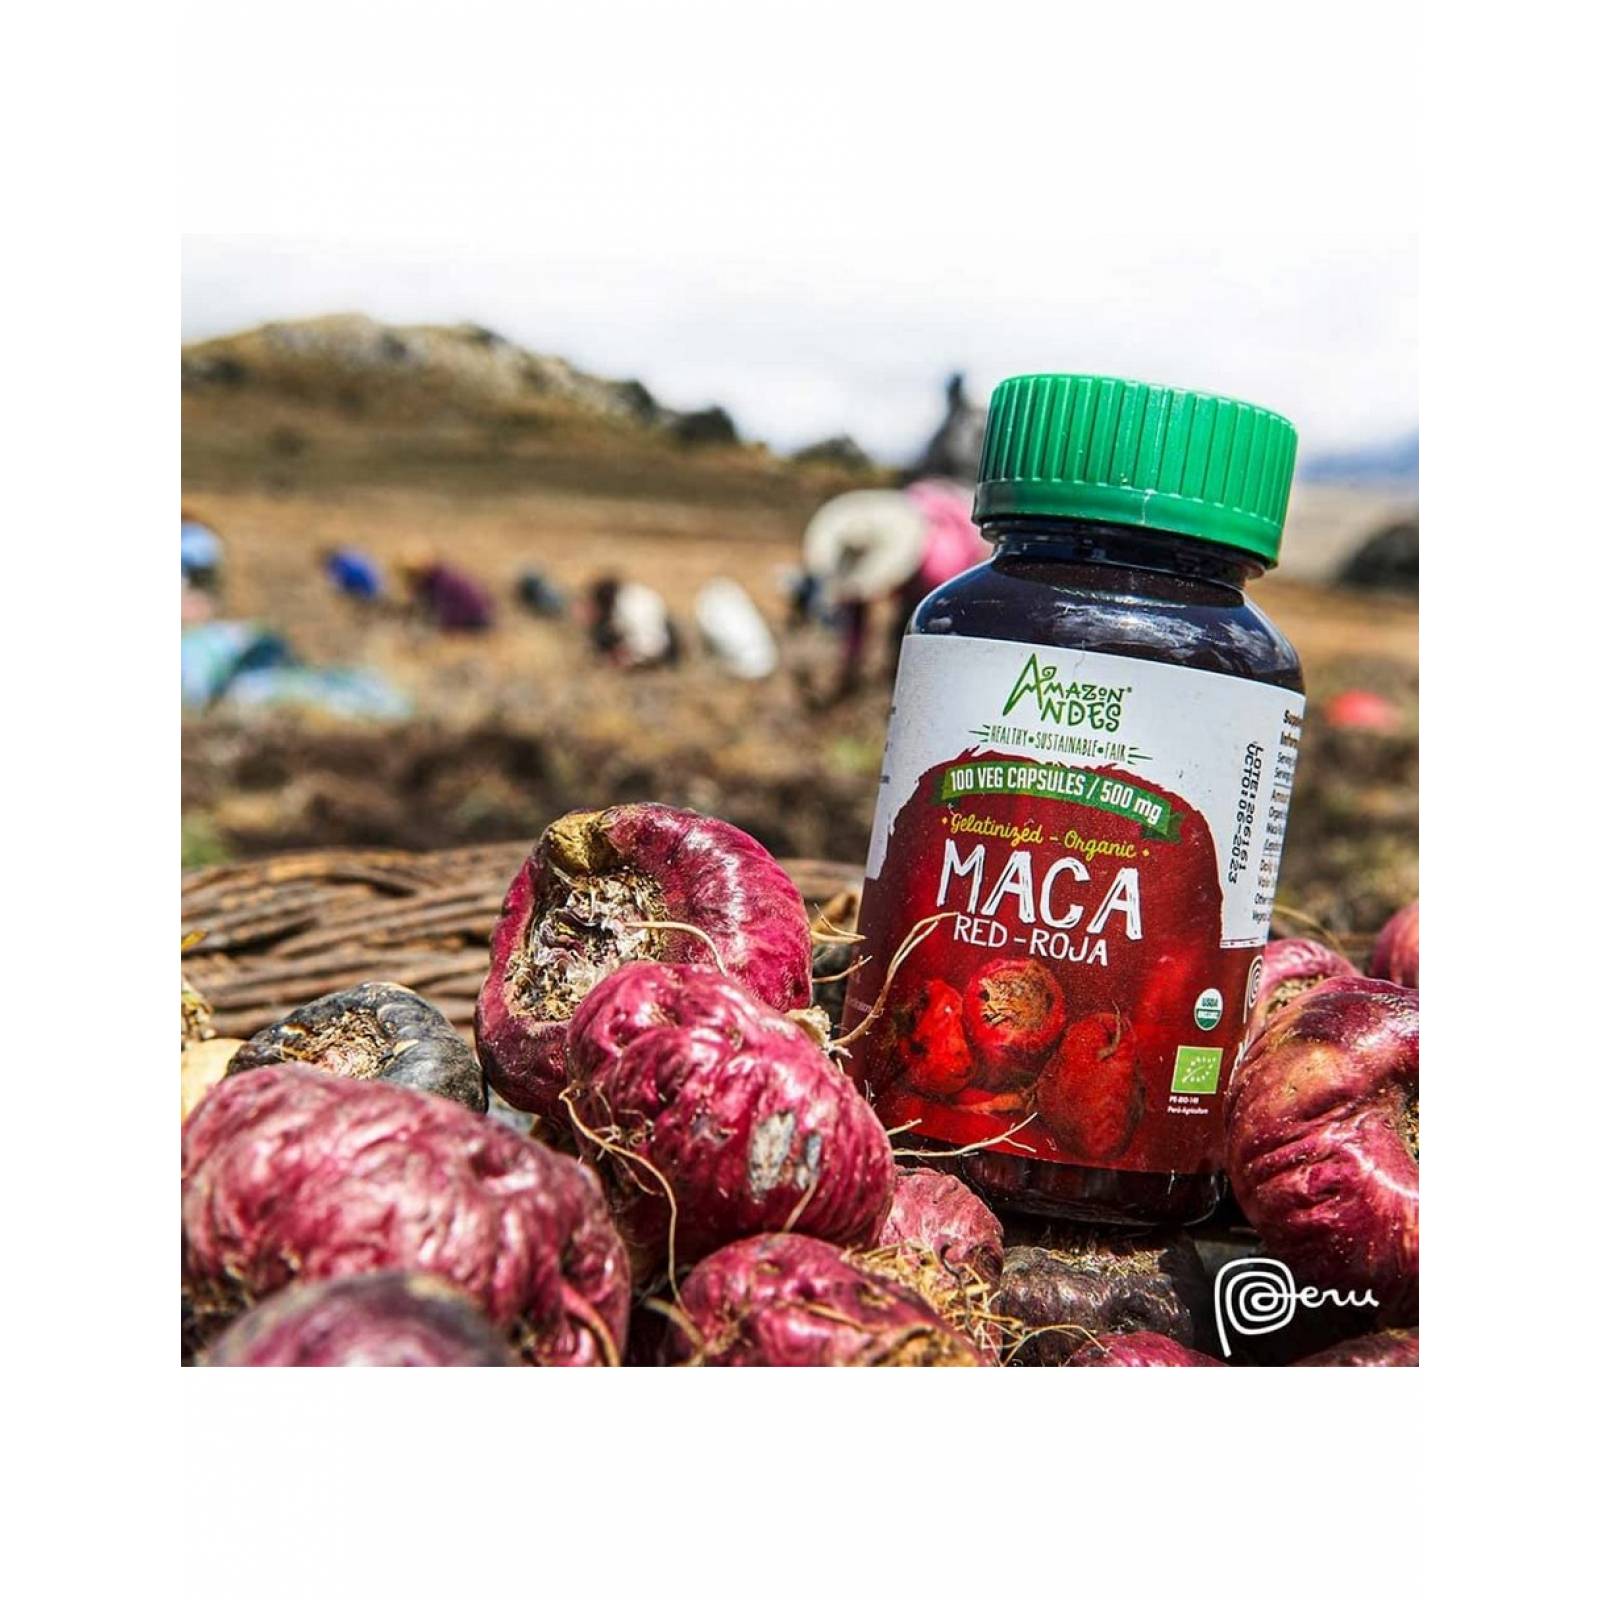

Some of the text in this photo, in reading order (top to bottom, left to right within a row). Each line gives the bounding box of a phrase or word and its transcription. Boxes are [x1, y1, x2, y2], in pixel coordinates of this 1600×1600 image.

[951, 767, 974, 791] 100
[977, 767, 1003, 788] VEG
[1007, 767, 1084, 796] CAPSULES
[1100, 781, 1134, 809] 500
[1133, 797, 1162, 825] mg
[951, 812, 1043, 846] Gelatinized
[1064, 829, 1137, 861] Organic
[936, 838, 1143, 940] MACA
